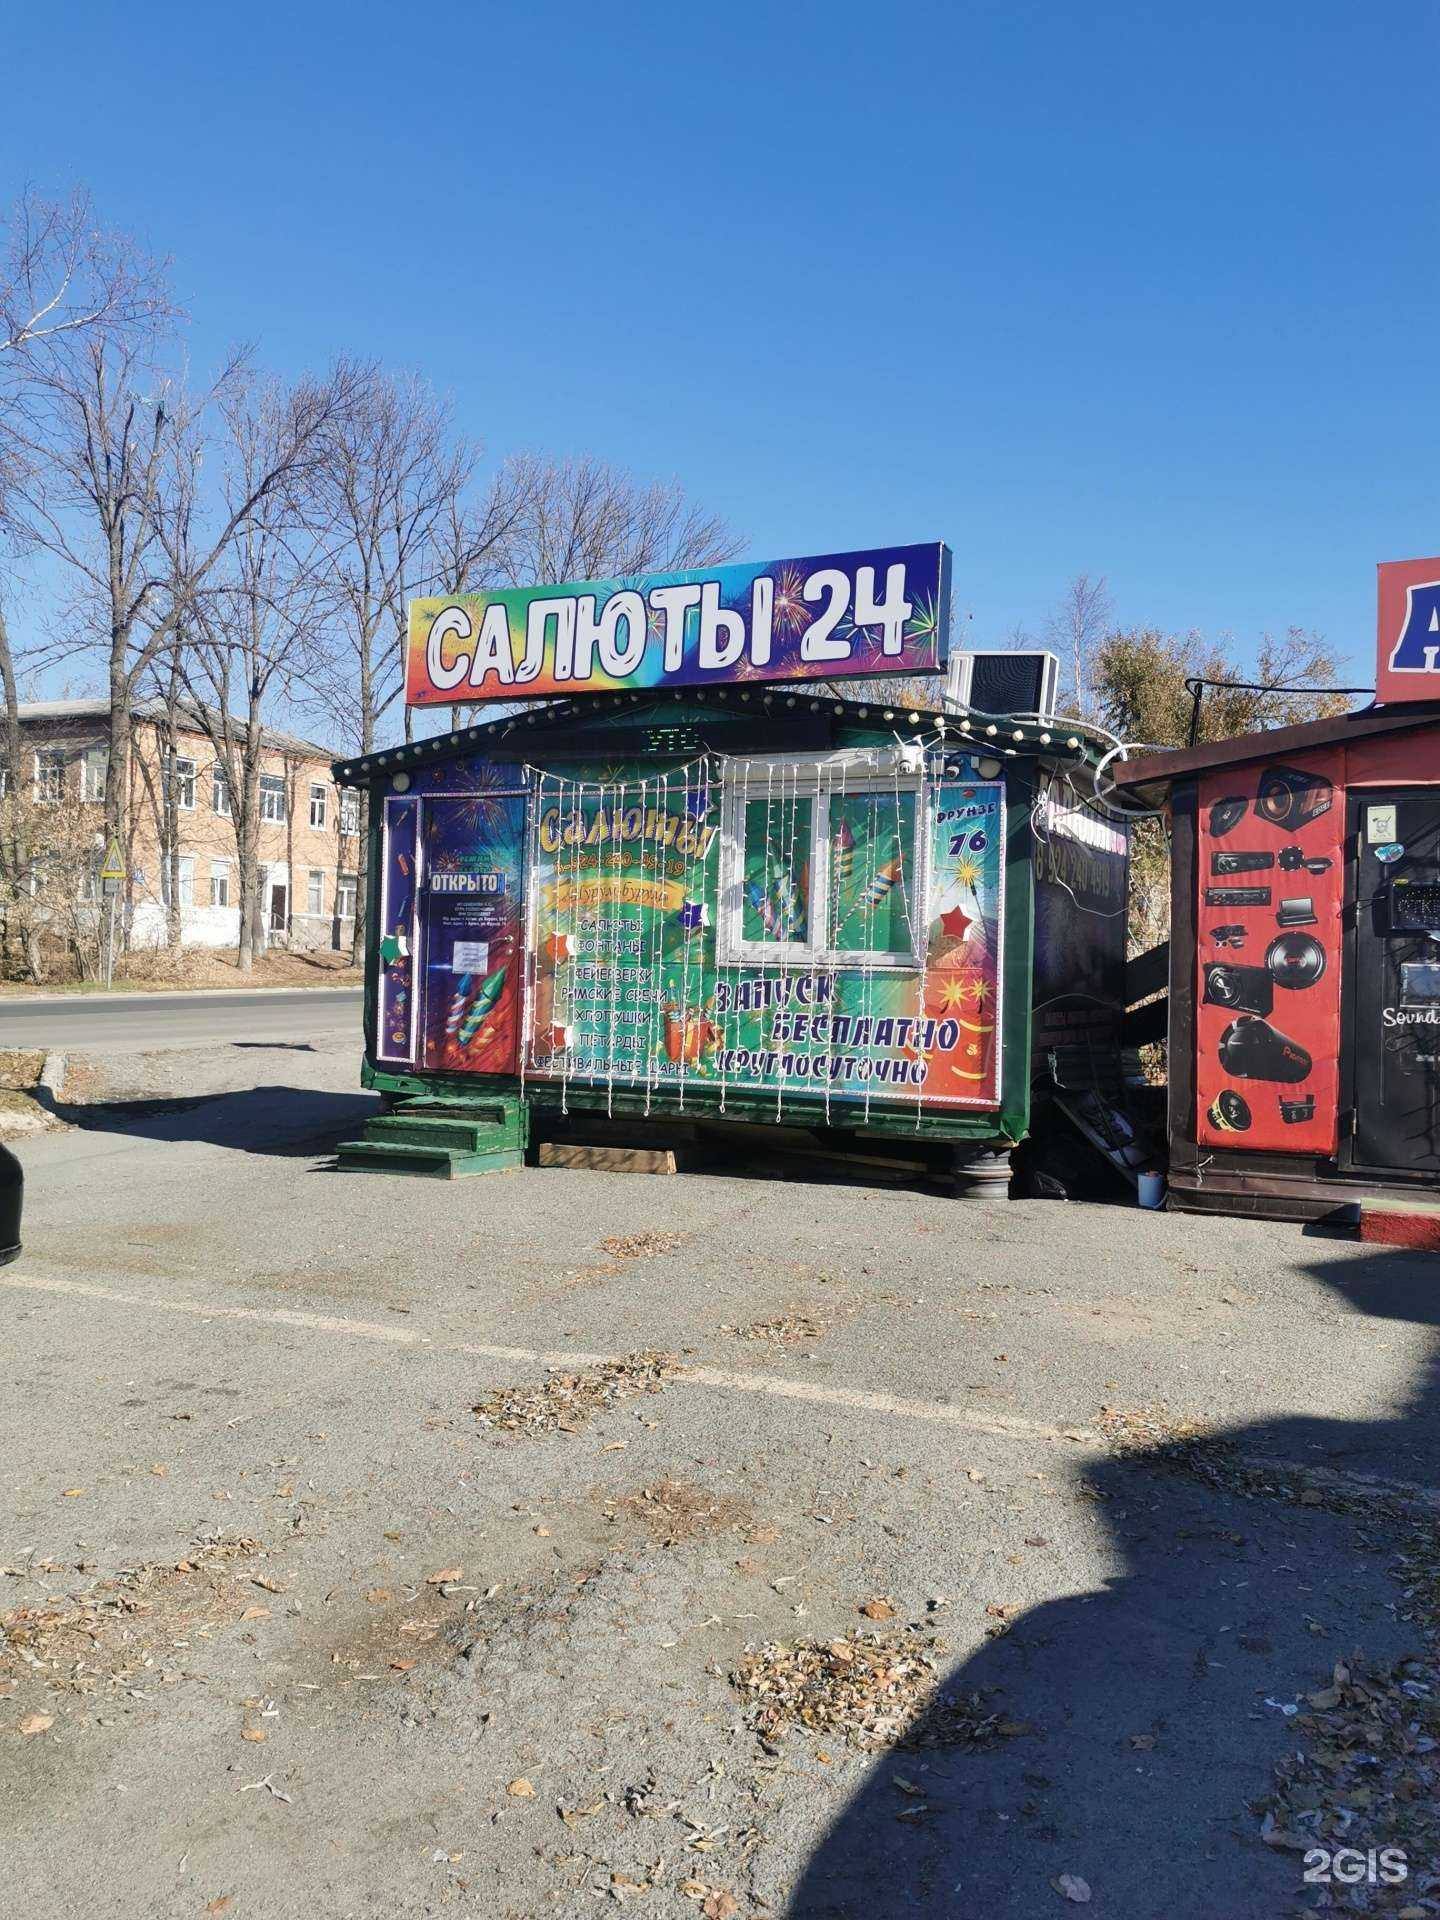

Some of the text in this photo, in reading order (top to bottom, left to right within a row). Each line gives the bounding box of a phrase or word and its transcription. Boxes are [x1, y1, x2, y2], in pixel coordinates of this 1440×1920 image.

[426, 563, 914, 691] САЛЮТЫ 24
[936, 802, 997, 826] ФРУНЗЕ
[540, 806, 717, 858] Салюты
[947, 829, 989, 858] 76
[432, 873, 498, 892] ОТКРЫТО
[580, 919, 643, 932] САЛЮТЫ
[577, 940, 646, 953] ФОНТАНЫ
[561, 987, 668, 1003] РИМСКИЕ СВЕЧИ
[714, 972, 839, 1013] ЗАПУСК
[575, 1009, 652, 1024] ХЛОПУШКИ
[579, 1033, 646, 1049] ПЕТАРДЫ
[771, 1012, 961, 1051] БЕСПЛАТНО
[535, 1056, 643, 1074] ФЕСТИВАЛЬНЫЕ
[717, 1049, 929, 1085] КРУГЛОСУТОЧНО
